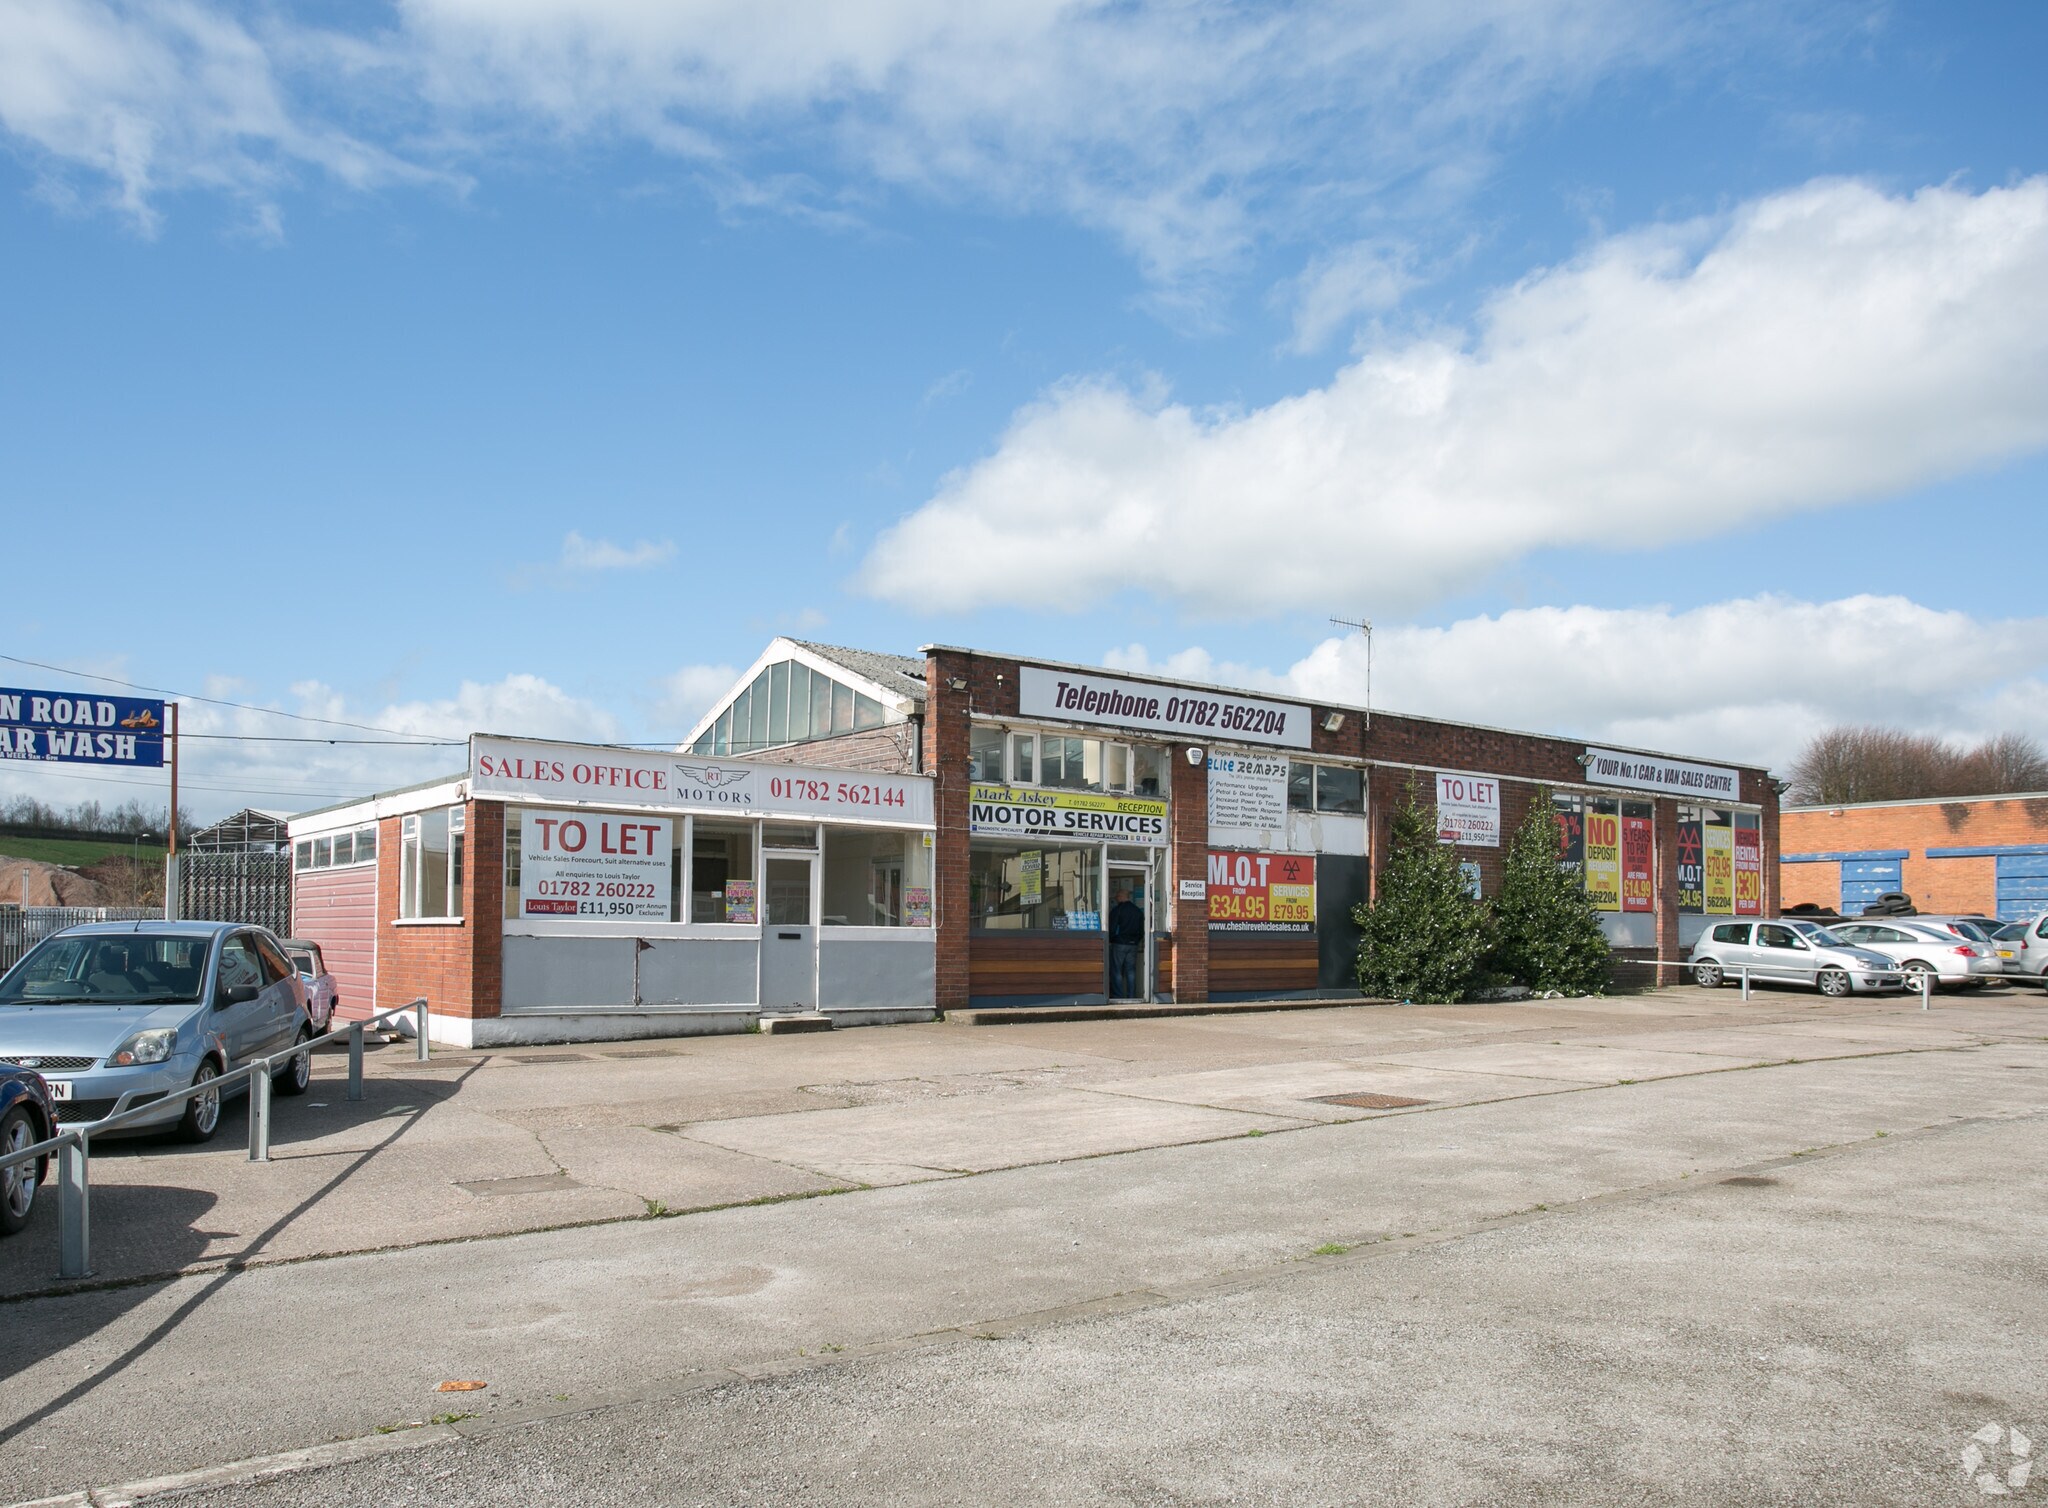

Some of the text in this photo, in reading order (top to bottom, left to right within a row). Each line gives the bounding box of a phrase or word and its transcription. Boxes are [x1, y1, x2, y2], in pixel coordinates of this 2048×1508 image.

[32, 697, 116, 726] ROAD
[1056, 682, 1286, 736] Telephone. 01782 562204
[47, 730, 136, 759] WASH
[480, 756, 667, 790] SALES OFFICE
[707, 772, 720, 781] RT
[1597, 758, 1618, 776] YOUR
[1639, 764, 1655, 781] CAR
[1656, 770, 1662, 782] &
[1664, 768, 1680, 784] VAN
[1681, 771, 1703, 788] SALES
[1704, 774, 1732, 791] CENTRE
[677, 788, 751, 804] MOTORS
[770, 777, 905, 807] 01782 562144
[974, 788, 1058, 808] Mark Askey
[1442, 779, 1494, 803] TO LET
[1117, 802, 1162, 813] RECEPTION
[972, 805, 1162, 834] MOTOR SERVICES
[1468, 820, 1493, 831] 260222
[535, 819, 661, 855] TO LET
[1588, 817, 1616, 846] NO
[1623, 829, 1650, 842] 5 YEARS
[1707, 829, 1730, 849] SERVICES
[1588, 846, 1616, 860] DEPOSIT
[1627, 842, 1648, 856] TO PAY
[1736, 846, 1759, 861] RENTAL
[1208, 855, 1270, 887] M.O.T
[1589, 861, 1616, 872] REQUIRED
[1707, 856, 1730, 878] £79.95
[1736, 861, 1759, 870] FROM ONLY
[566, 871, 595, 880] enquiries
[538, 880, 655, 898] 01782 260222
[1273, 886, 1310, 897] SERVICES
[1624, 880, 1650, 897] £14.99
[1737, 871, 1759, 900] £30
[528, 902, 576, 912] Louis Taylor
[580, 902, 634, 916] £11,950
[1210, 895, 1265, 918] £34.95
[1707, 896, 1731, 908] 562204
[1739, 900, 1747, 908] PER
[1274, 905, 1309, 920] £79.95
[1208, 921, 1309, 932] www.cheshirevehiclesales.co.uk
